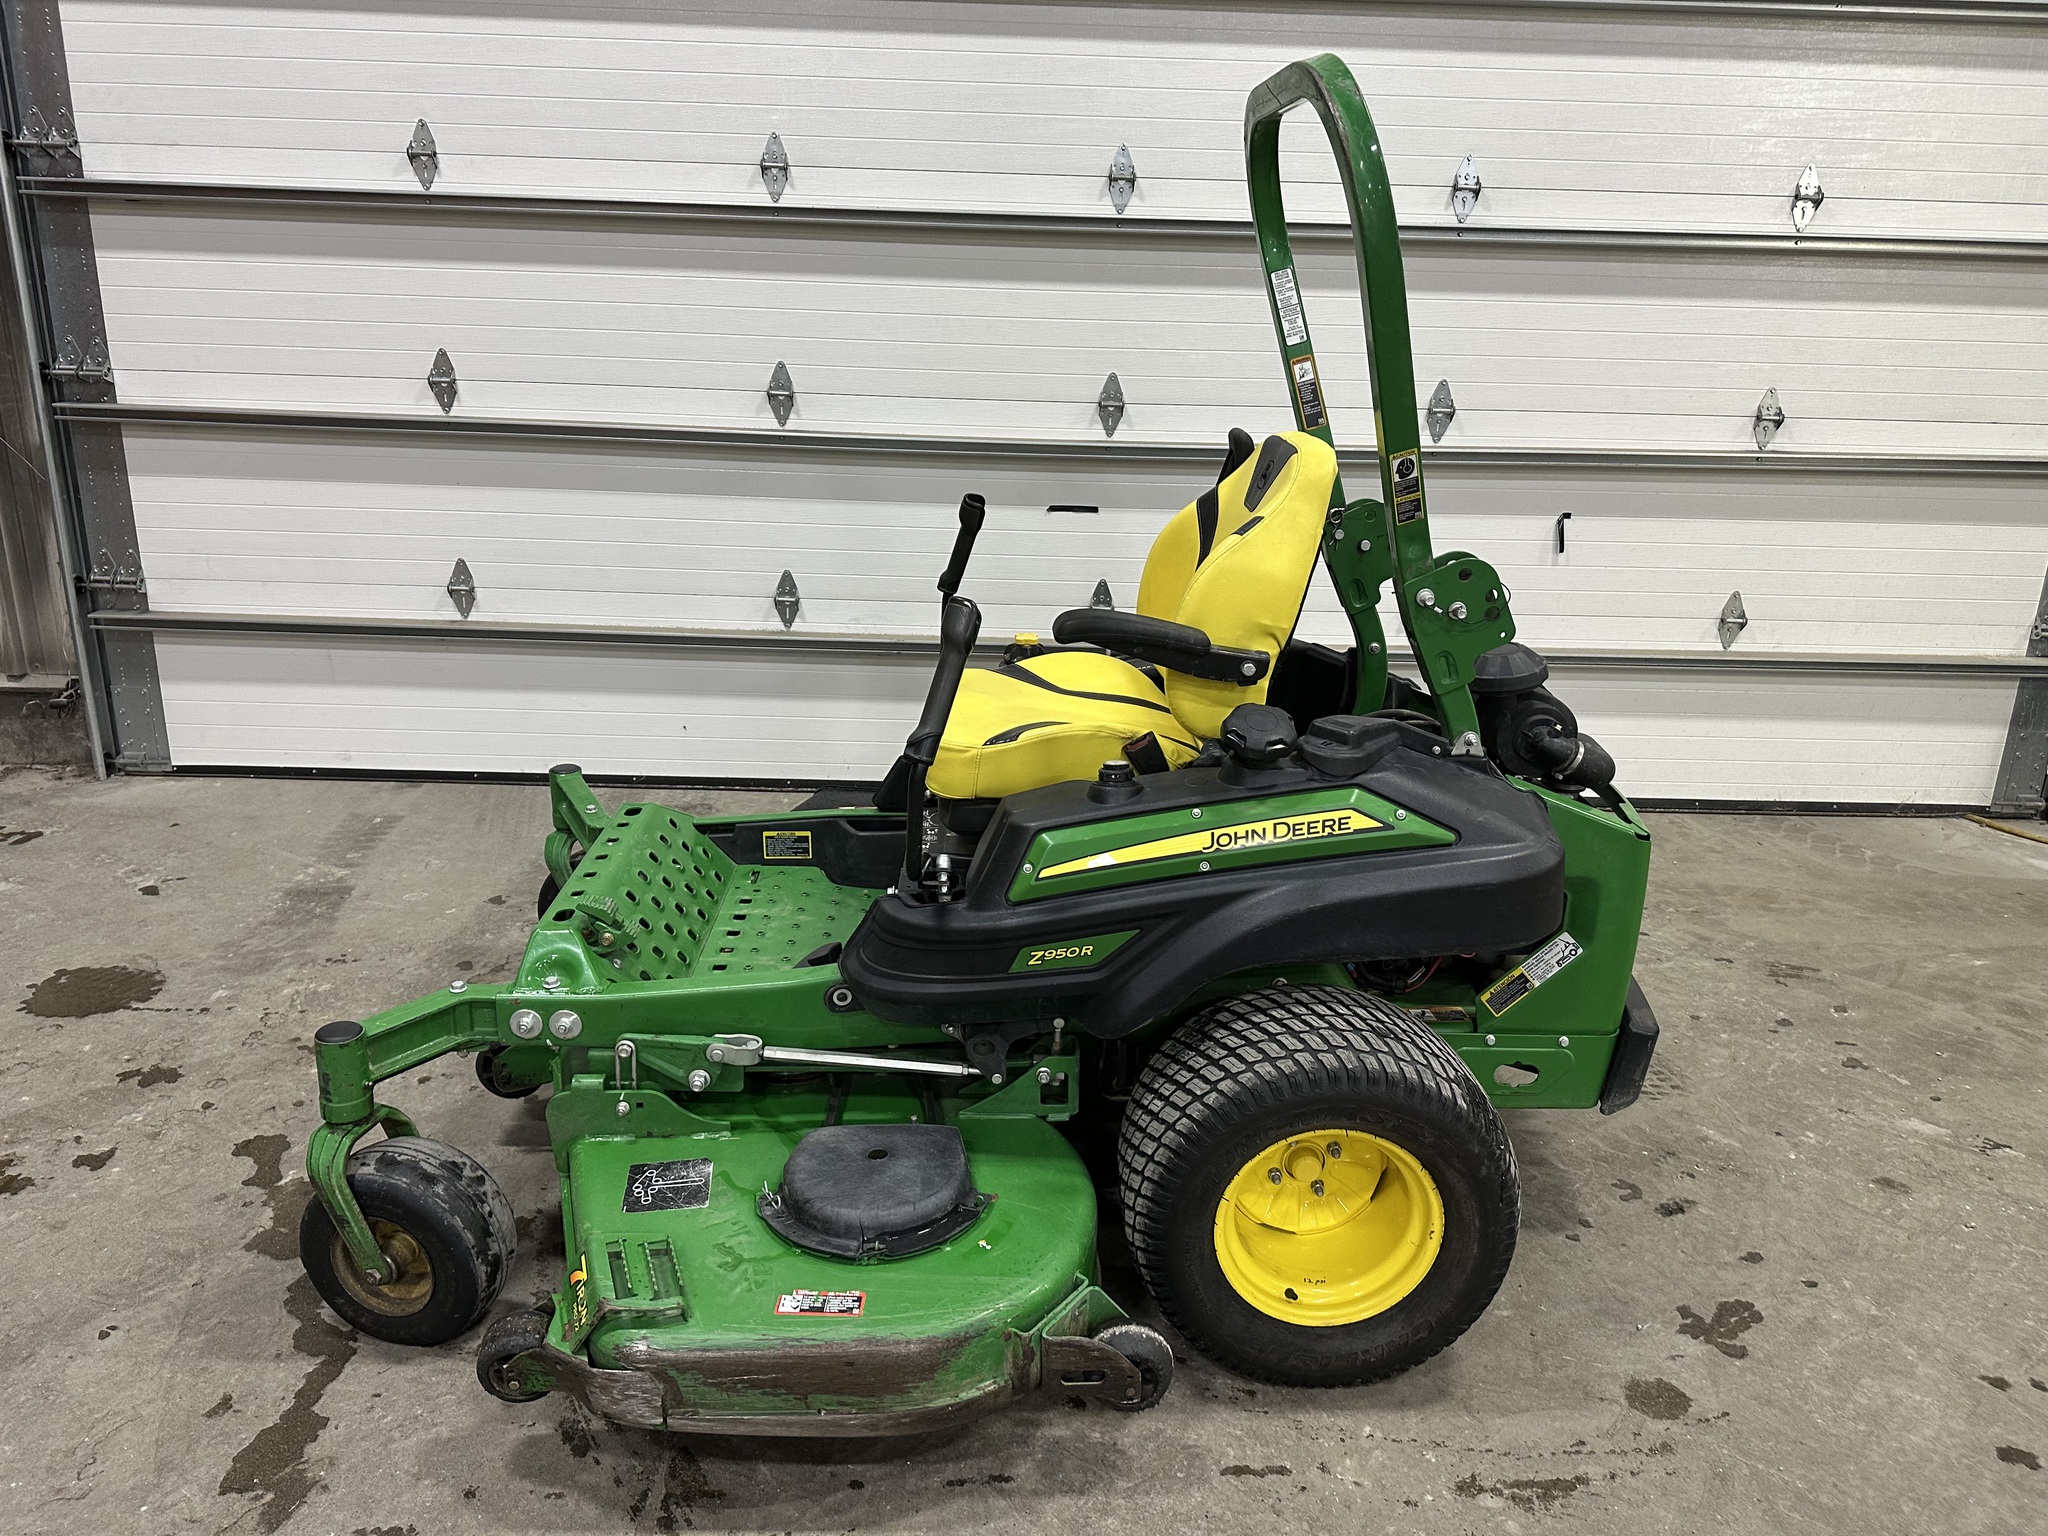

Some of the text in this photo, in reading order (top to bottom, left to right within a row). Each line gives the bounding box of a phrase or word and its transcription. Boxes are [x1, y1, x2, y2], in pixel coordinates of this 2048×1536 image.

[1202, 816, 1352, 851] JOHN DEERE
[1493, 974, 1516, 993] ATENCIÓN
[1315, 1276, 1326, 1286] psi
